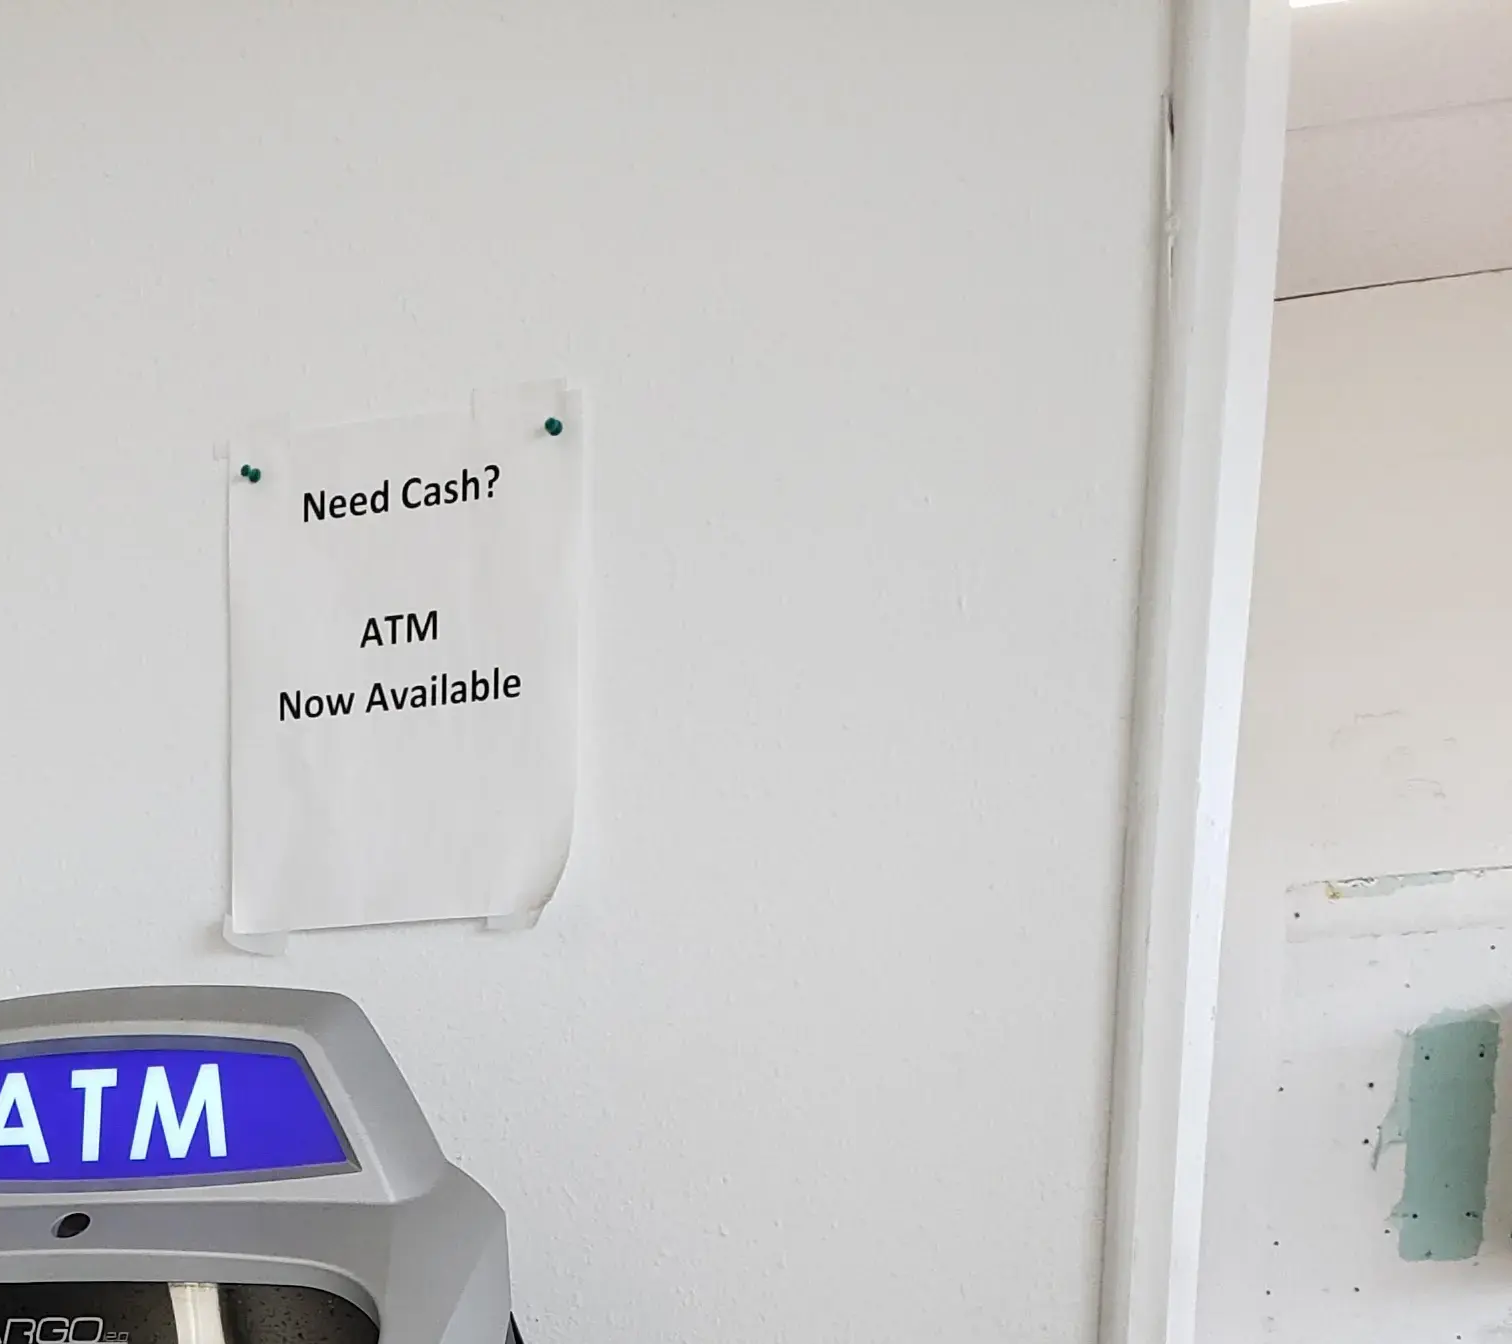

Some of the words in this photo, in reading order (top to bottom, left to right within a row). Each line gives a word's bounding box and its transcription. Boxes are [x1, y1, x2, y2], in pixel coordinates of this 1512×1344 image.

[303, 479, 389, 523] Need
[401, 464, 500, 509] Cash?
[360, 610, 438, 648] ATM
[279, 690, 355, 722] Now
[365, 667, 521, 712] Available
